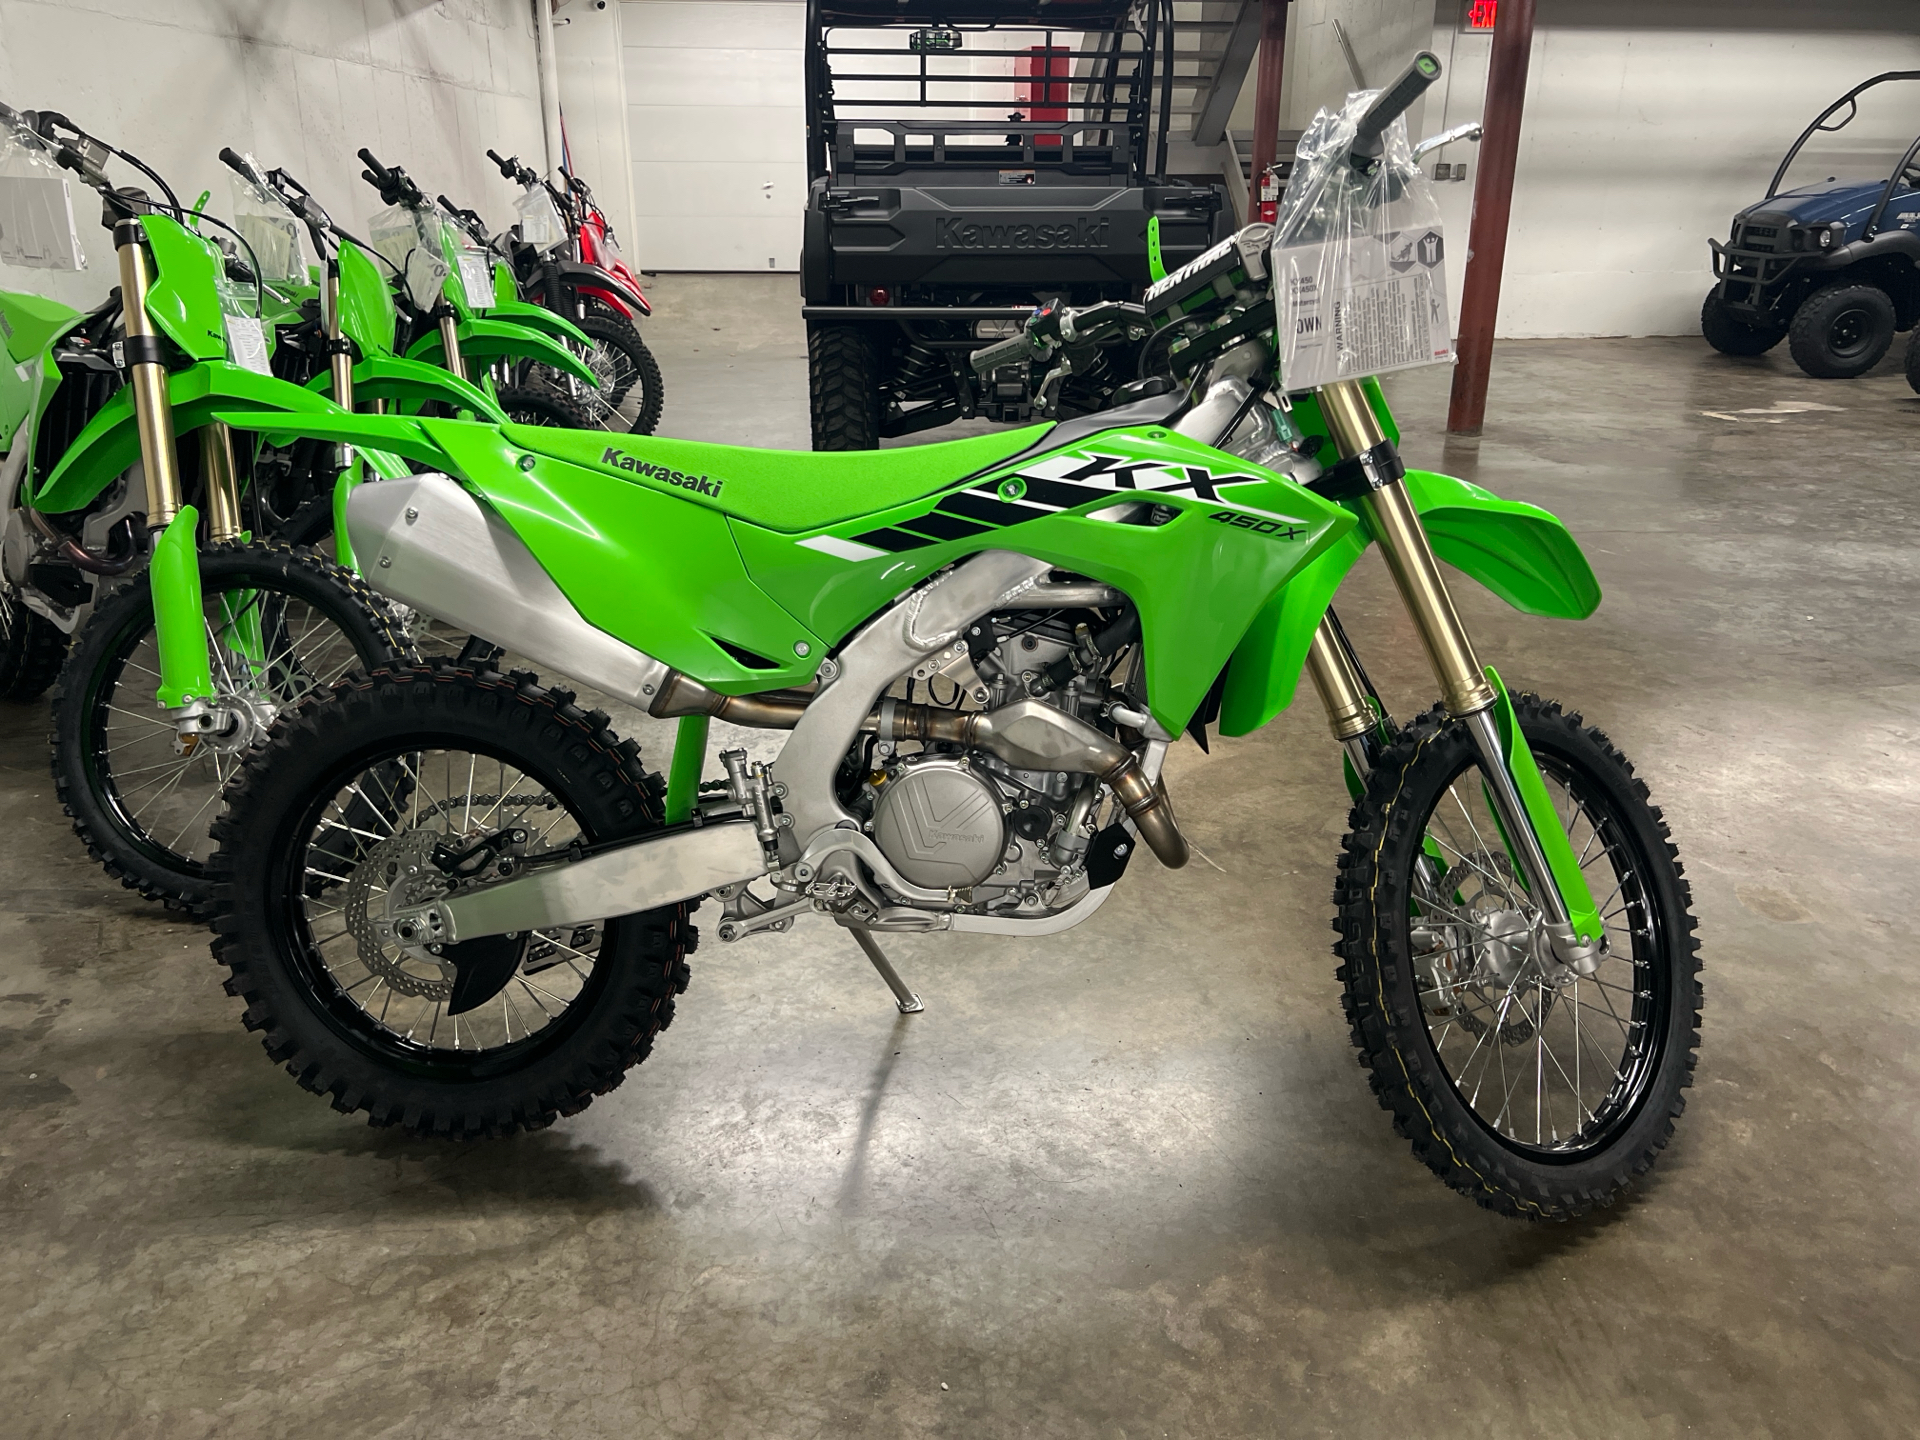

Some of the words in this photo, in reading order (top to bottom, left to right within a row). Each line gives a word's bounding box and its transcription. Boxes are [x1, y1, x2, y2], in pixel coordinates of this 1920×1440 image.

[936, 217, 1110, 249] Kawasaki
[1334, 301, 1344, 353] WARNING
[601, 447, 723, 498] Kawasaki
[1058, 454, 1262, 504] KX
[1208, 511, 1306, 540] 450X
[928, 829, 985, 843] Kawasaki
